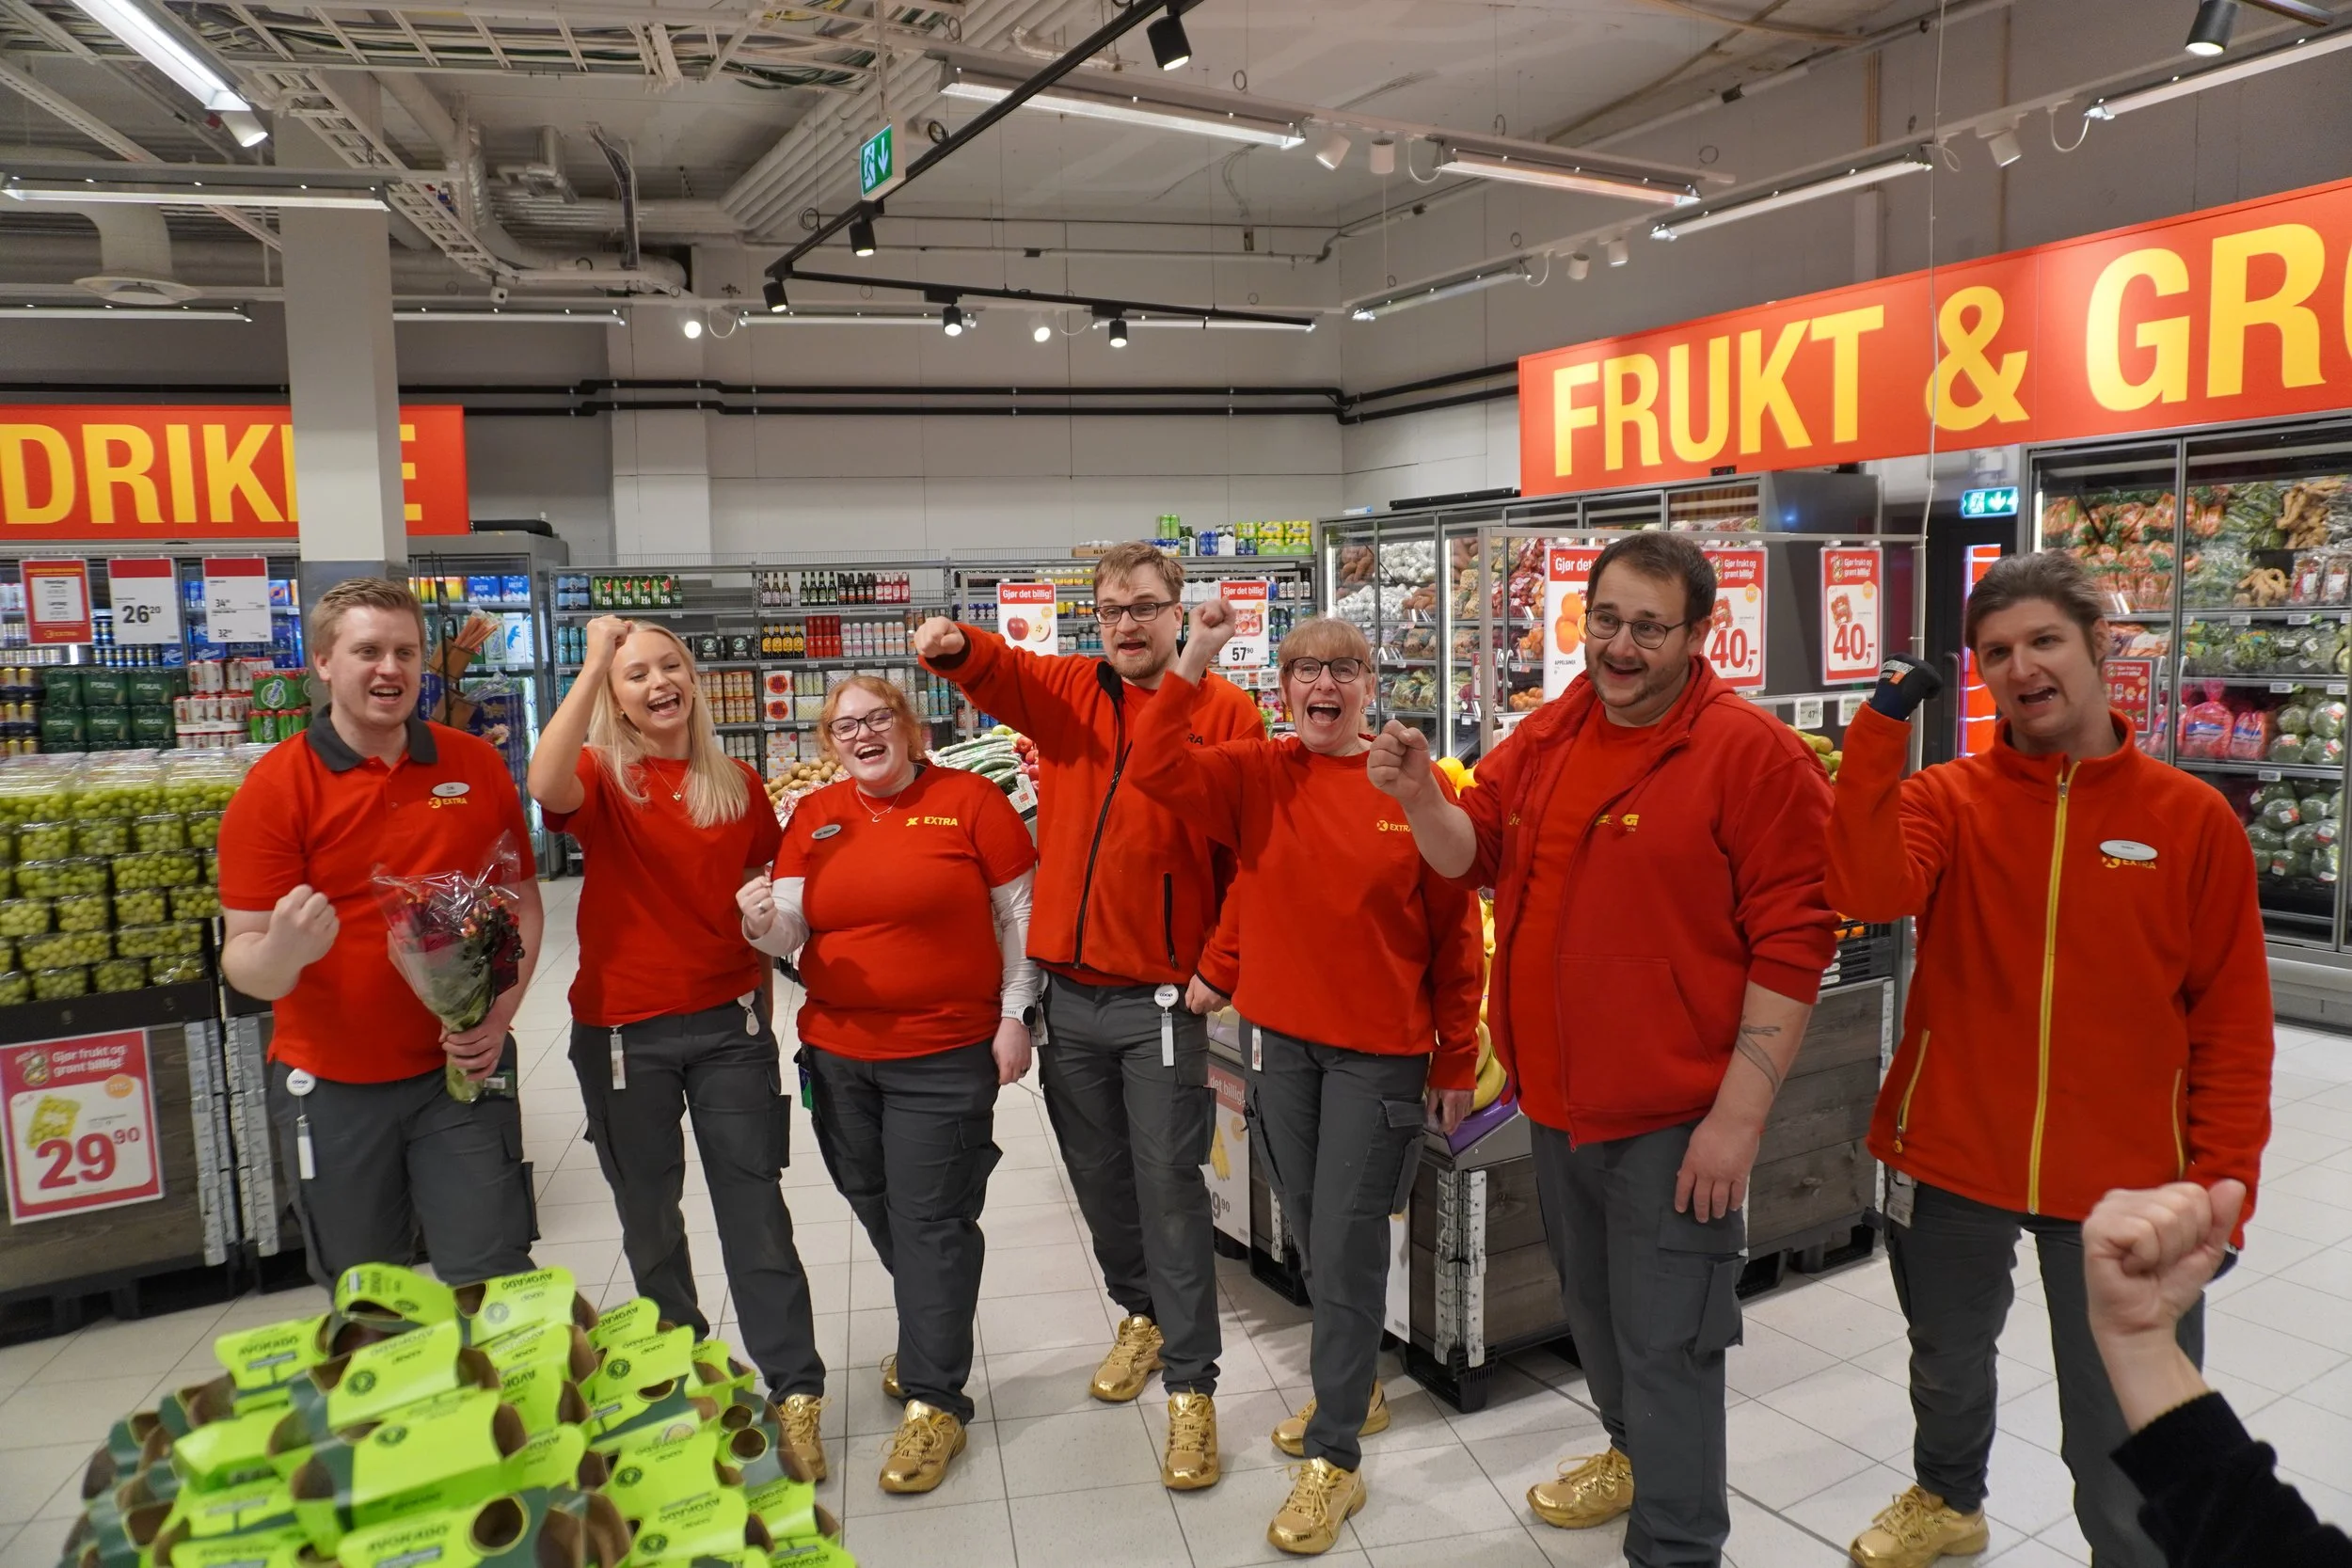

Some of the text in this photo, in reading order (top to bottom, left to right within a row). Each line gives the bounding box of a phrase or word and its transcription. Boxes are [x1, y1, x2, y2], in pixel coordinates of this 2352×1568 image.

[1552, 223, 2352, 478] FRUKT & GR
[1555, 557, 1593, 574] Gjør det
[1003, 590, 1052, 600] Gjør det billig!
[1223, 587, 1265, 596] Gjør det billig!
[122, 605, 150, 624] 26
[1232, 647, 1247, 661] 57
[136, 682, 162, 690] POKAL
[924, 816, 959, 826] EXTRA
[52, 1045, 128, 1064] Gjør frukt og
[54, 1057, 122, 1078] grønt billig!
[1210, 1078, 1244, 1106] det billig!
[36, 1126, 141, 1191] 29 90
[501, 1272, 553, 1291] AVOKADO
